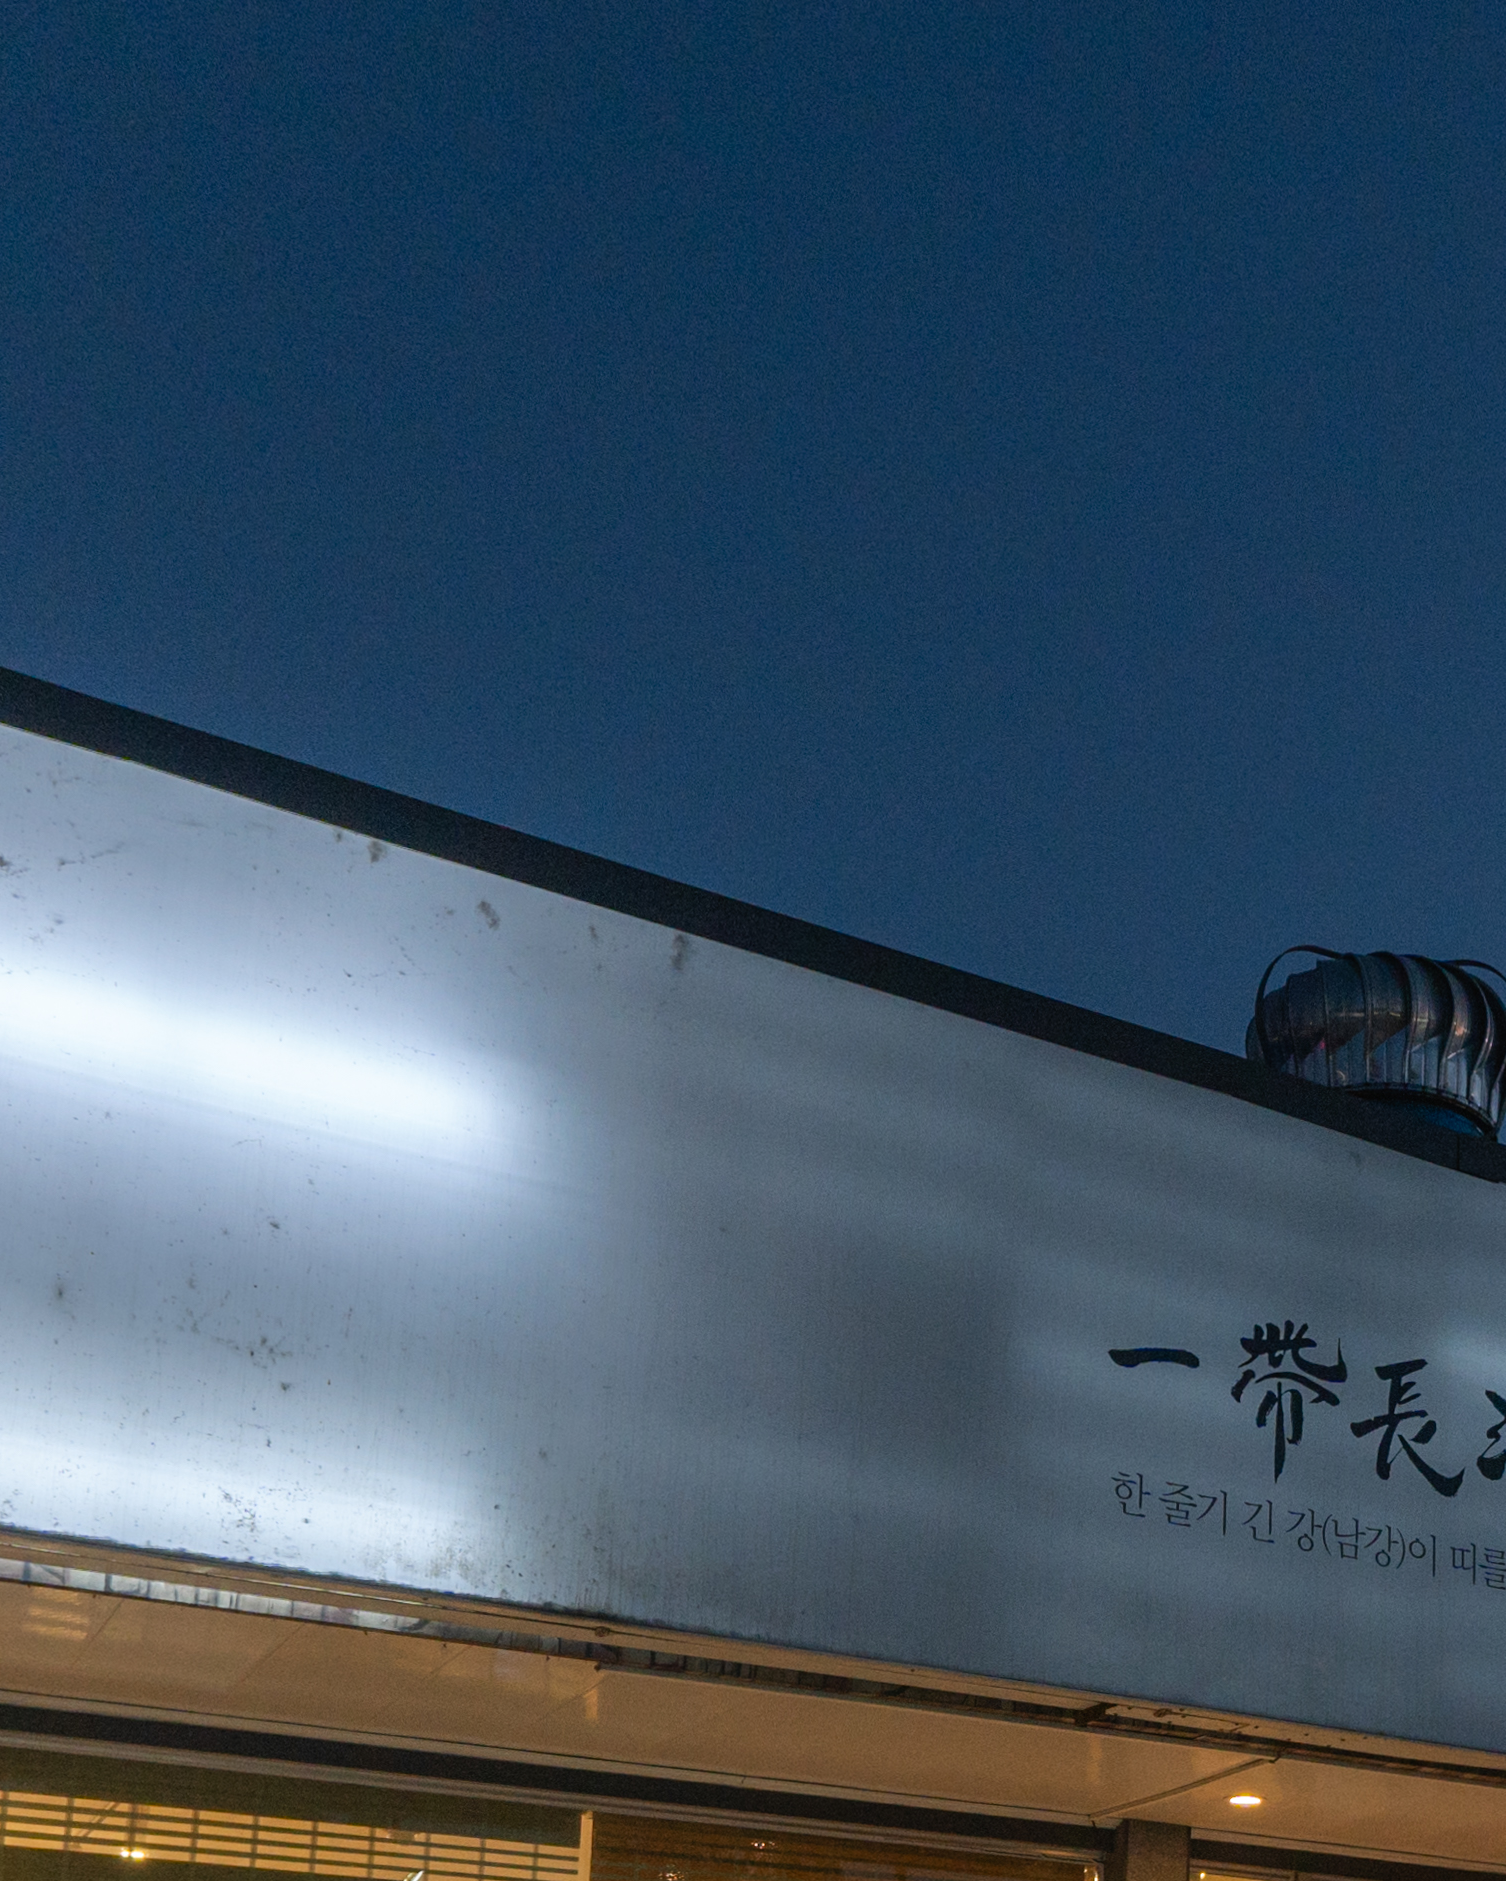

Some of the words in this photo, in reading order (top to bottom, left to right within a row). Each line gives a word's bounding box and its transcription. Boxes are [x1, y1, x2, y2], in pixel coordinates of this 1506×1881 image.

[1112, 1472, 1151, 1518] 한
[1159, 1481, 1227, 1536] 줄기
[1242, 1500, 1275, 1544] 긴
[1286, 1508, 1436, 1577] 강(남강)이
